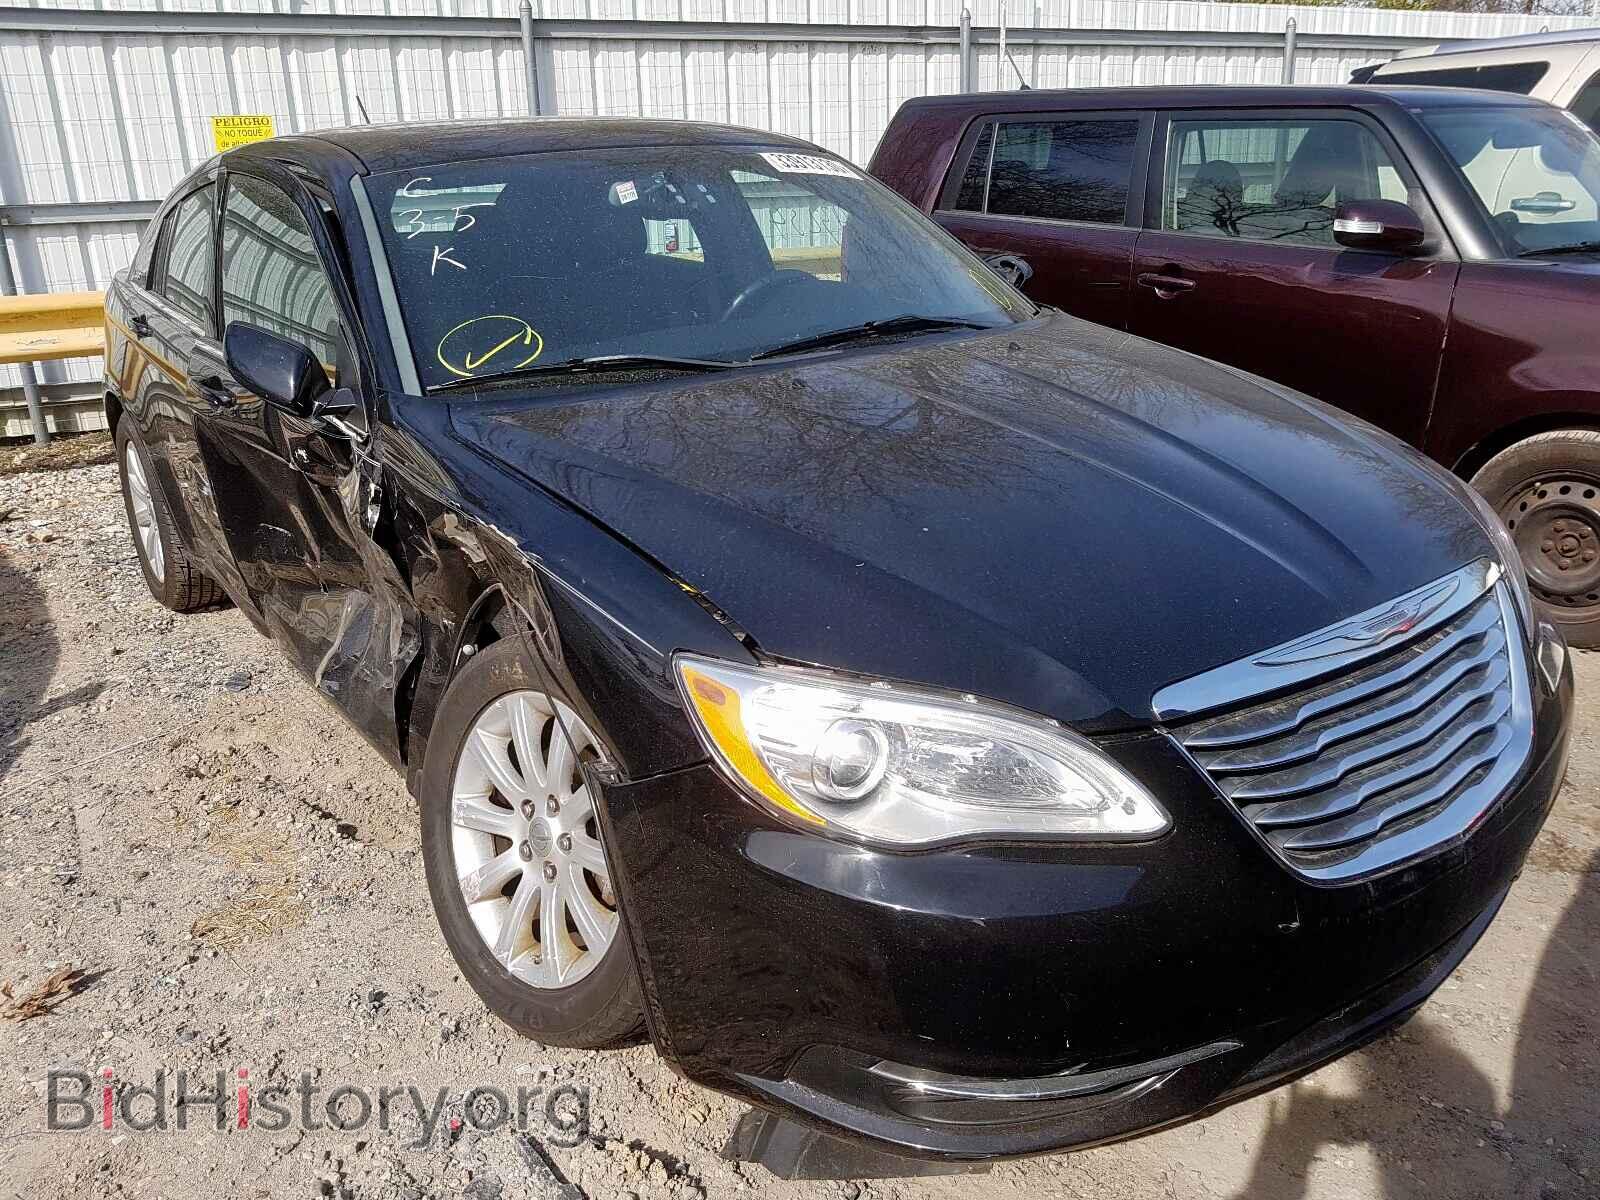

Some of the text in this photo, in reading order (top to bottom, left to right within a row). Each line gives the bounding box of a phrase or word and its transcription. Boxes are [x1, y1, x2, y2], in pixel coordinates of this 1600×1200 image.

[215, 118, 270, 126] PELIGRO
[224, 129, 263, 137] NO TOQUE
[431, 245, 467, 276] K
